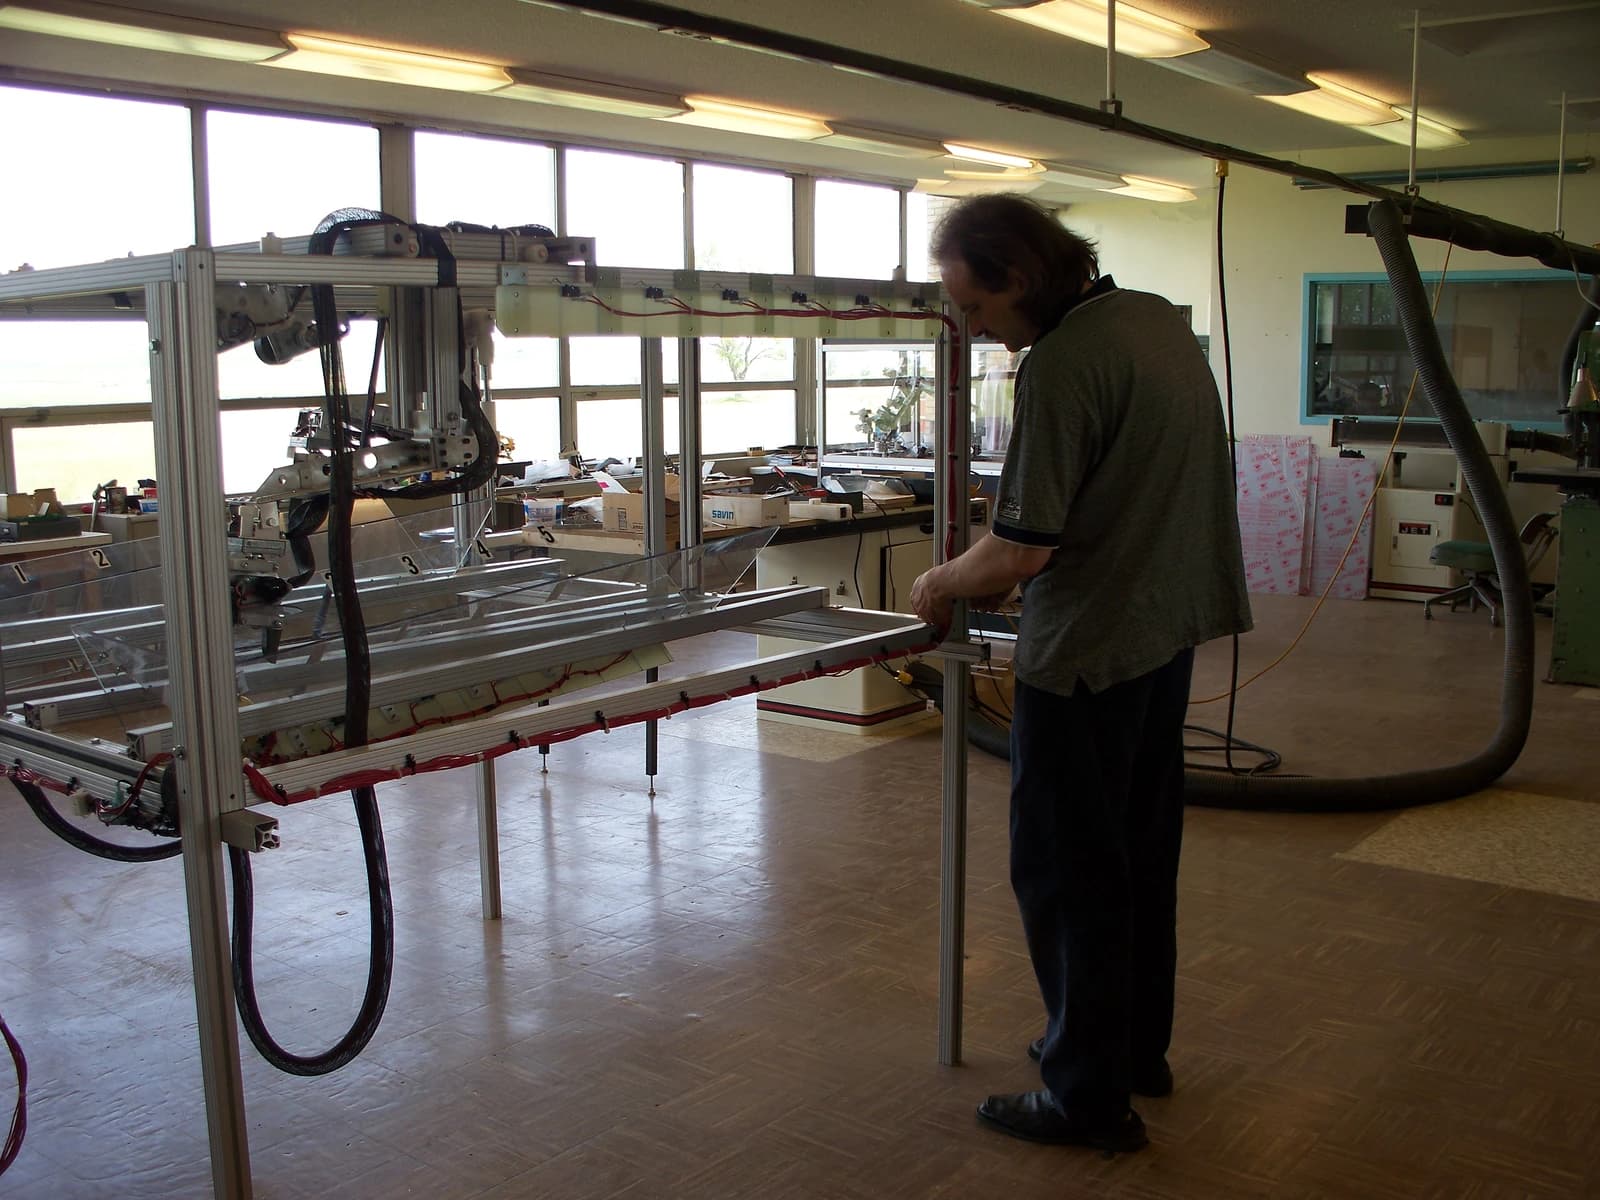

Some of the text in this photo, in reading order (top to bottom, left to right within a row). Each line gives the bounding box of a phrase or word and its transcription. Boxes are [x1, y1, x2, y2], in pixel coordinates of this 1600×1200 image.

[711, 509, 734, 520] savin
[537, 525, 555, 543] 5
[1401, 527, 1429, 535] JET
[92, 549, 109, 567] 2
[476, 540, 492, 558] 4
[14, 564, 27, 583] 1
[401, 555, 419, 575] 3
